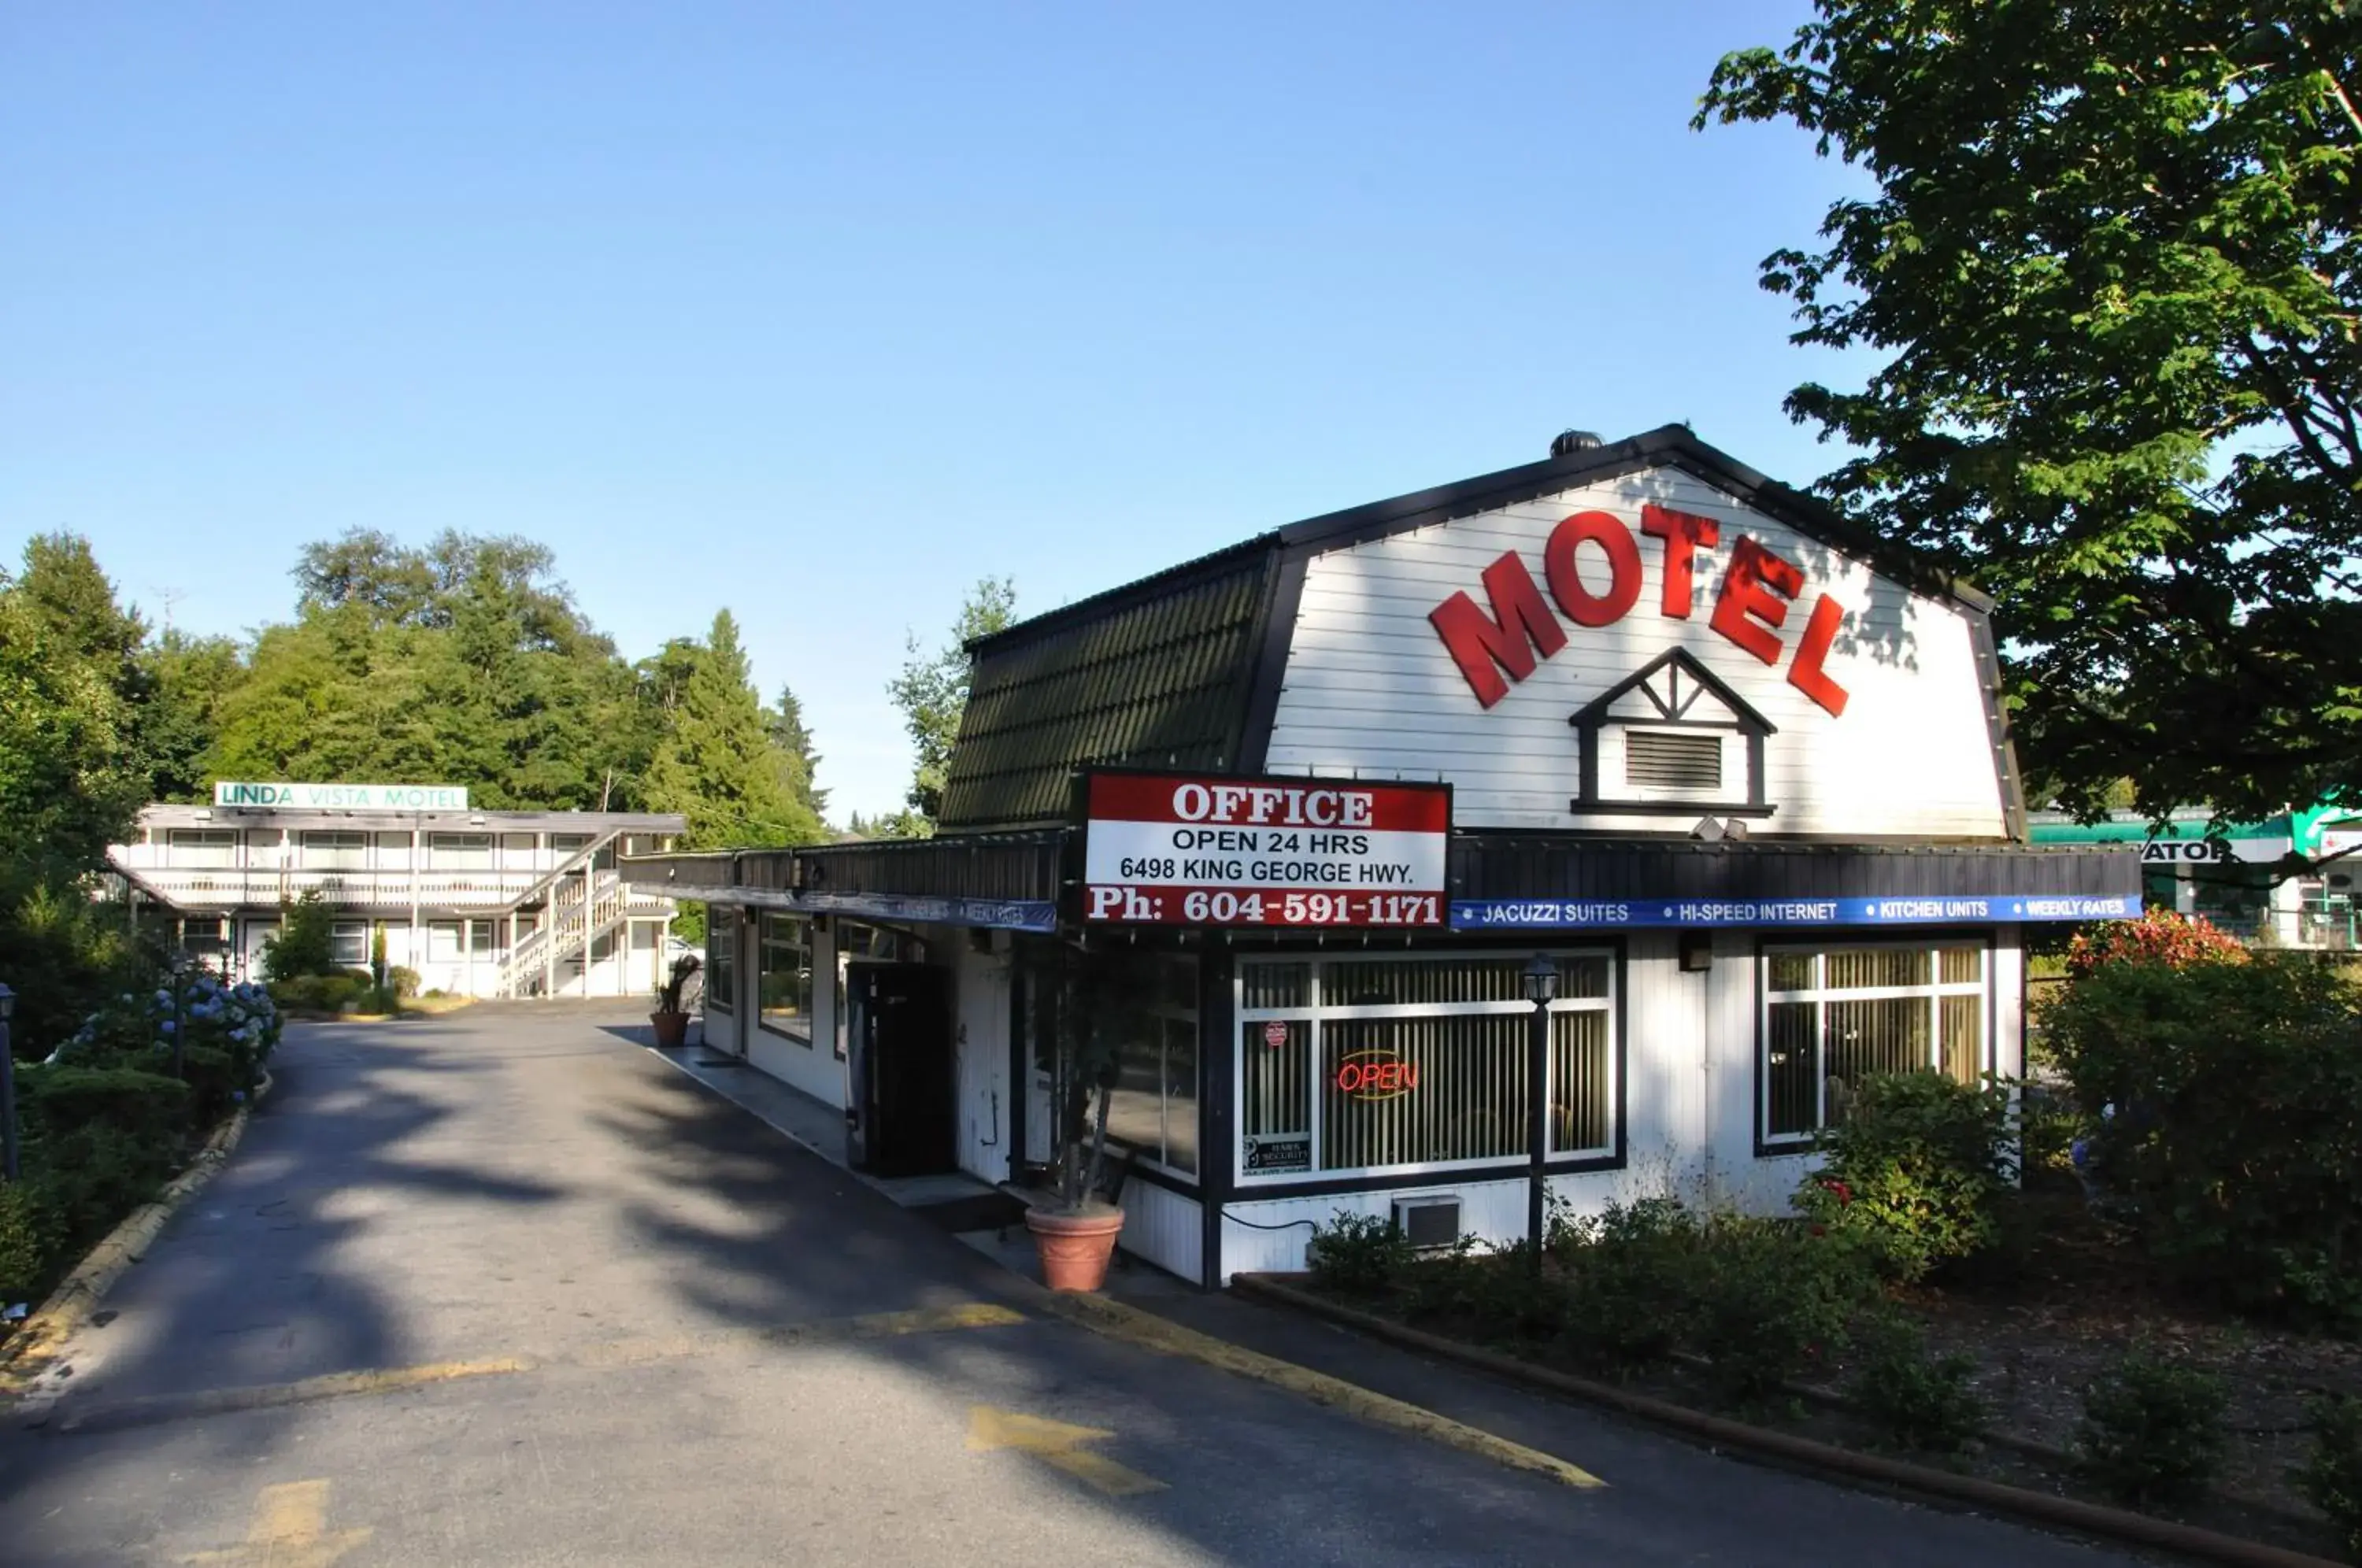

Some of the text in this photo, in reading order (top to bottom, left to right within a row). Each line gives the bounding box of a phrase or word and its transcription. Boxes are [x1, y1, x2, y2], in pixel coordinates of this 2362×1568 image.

[1427, 504, 1849, 718] MOTEL
[222, 786, 460, 807] LINDA VISTA MOTEL
[1172, 783, 1373, 827] OFFICE
[1172, 829, 1368, 855] OPEN 24 HRS
[1120, 857, 1414, 883] 6498 KING GEORGE HWY.
[1088, 886, 1440, 923] Ph: 604-591-1171
[1483, 904, 1628, 923] JACUZZI SUITES
[1679, 903, 1837, 921] HI-SPEED INTERNET
[1881, 900, 1987, 919] KITCHEN UNITS
[2027, 899, 2125, 916] WEEKLY RATES
[1338, 1062, 1418, 1092] OPEN
